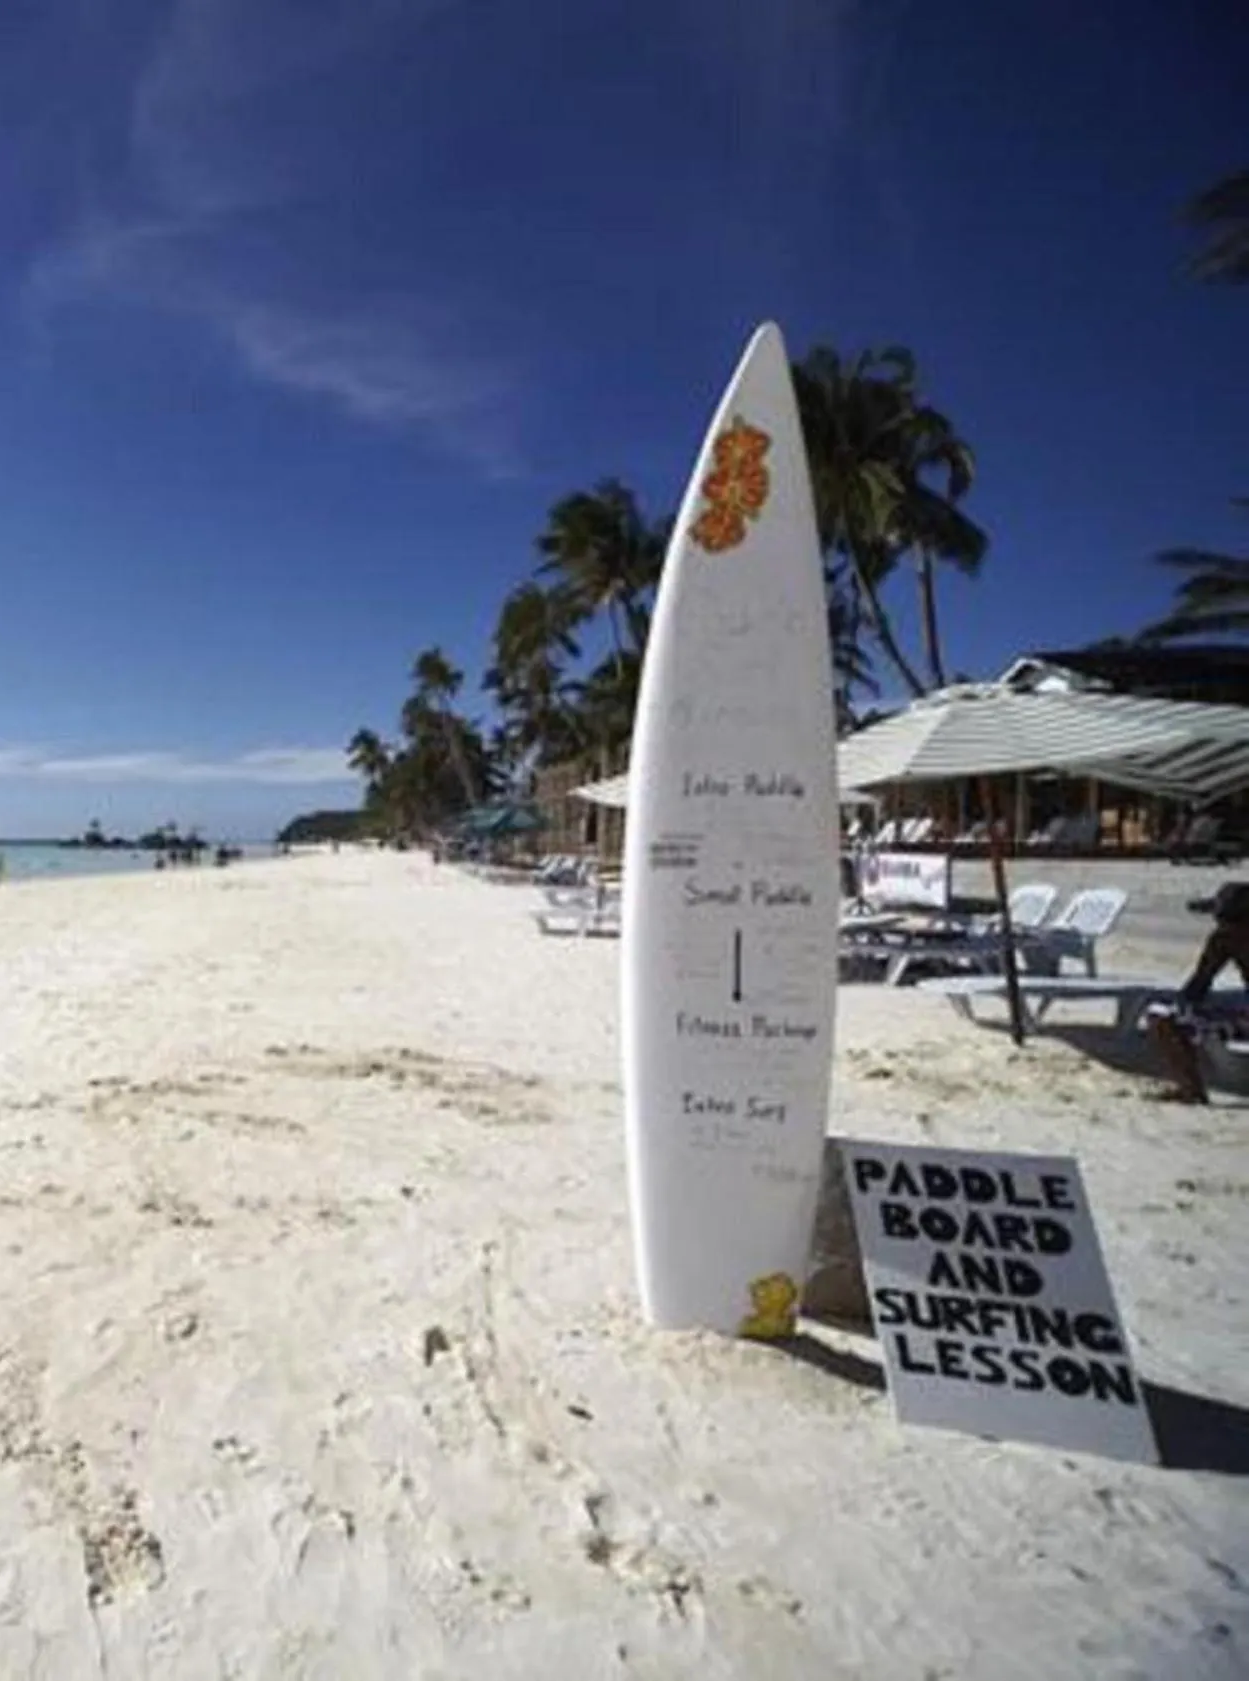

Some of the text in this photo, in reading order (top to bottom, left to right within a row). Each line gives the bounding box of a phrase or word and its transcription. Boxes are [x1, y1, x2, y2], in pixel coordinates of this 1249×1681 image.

[853, 1158, 1077, 1211] PADDLE
[879, 1201, 1073, 1256] BOARD
[928, 1251, 1044, 1298] AND
[874, 1287, 1125, 1355] SURFING
[895, 1334, 1139, 1406] LESSON
